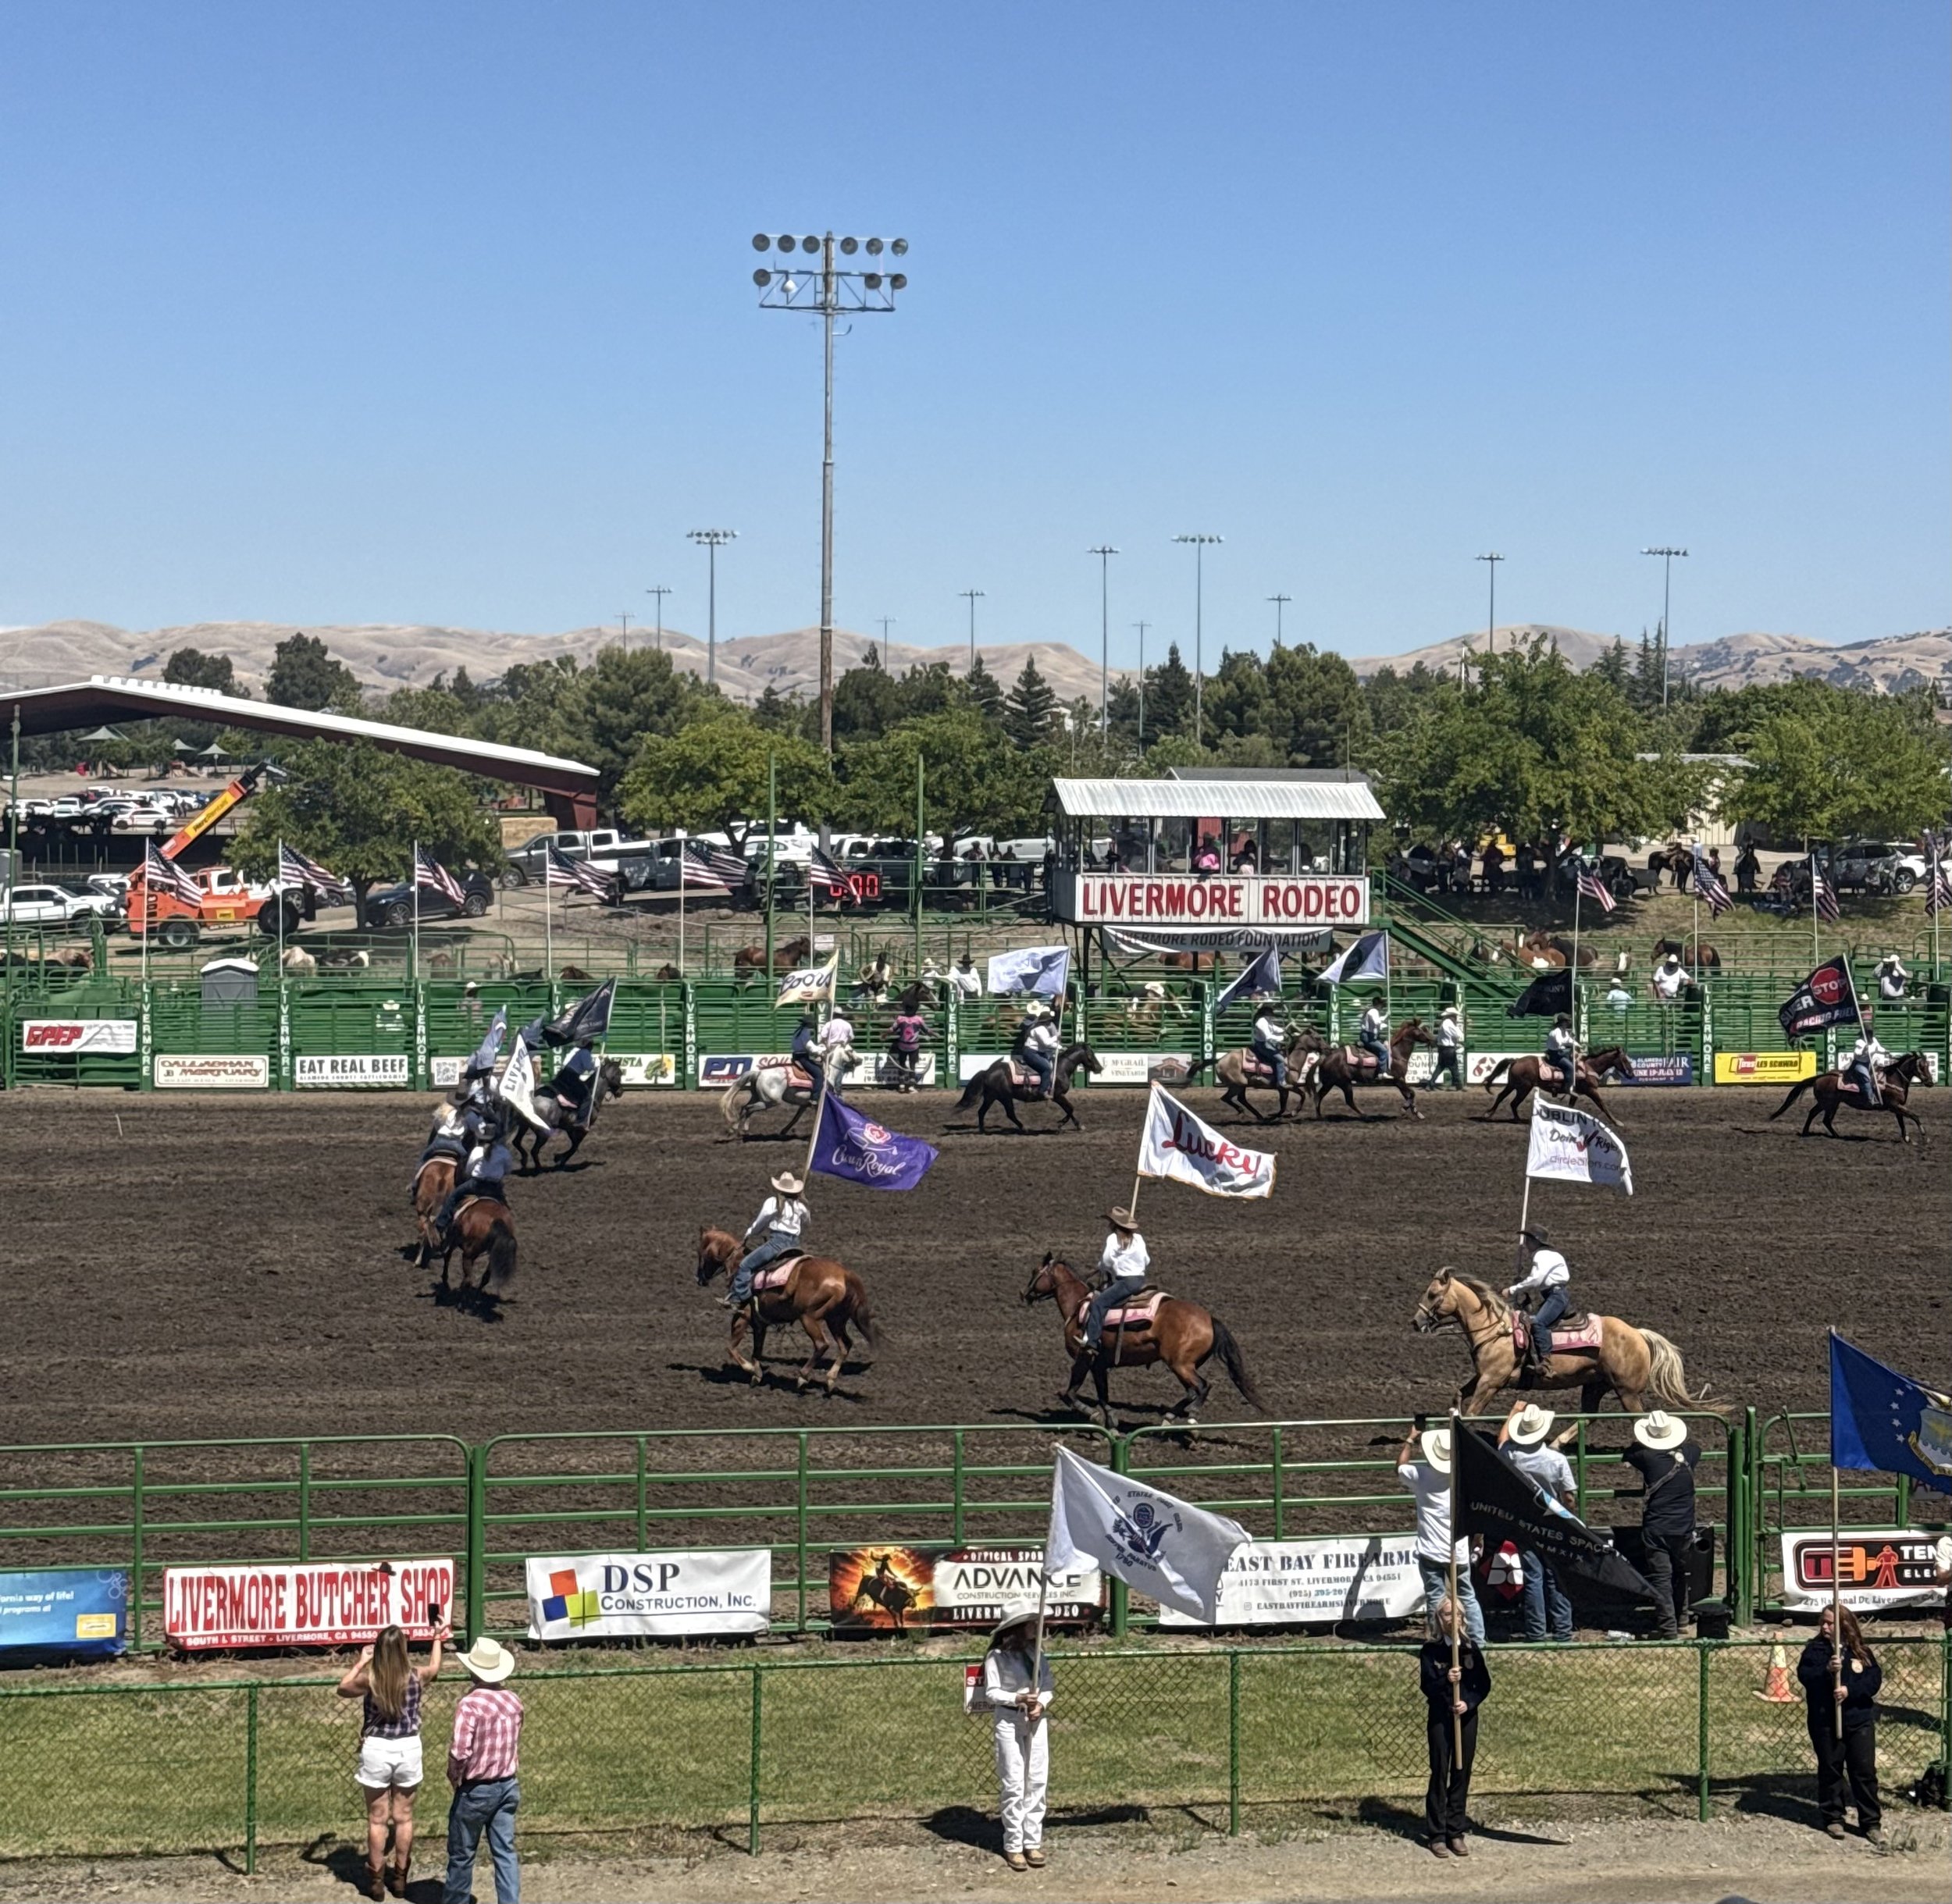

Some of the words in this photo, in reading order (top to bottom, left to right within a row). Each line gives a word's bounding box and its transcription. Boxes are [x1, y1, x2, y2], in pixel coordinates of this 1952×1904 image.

[1083, 882, 1243, 916] LIVERMORE
[1263, 884, 1360, 917] RODEO
[1191, 933, 1234, 946] RODEO
[1812, 974, 1847, 995] STOP
[142, 982, 152, 1077] LIVERMORE
[280, 984, 290, 1077] LIVERMORE
[416, 984, 426, 1075] LIVERMORE
[686, 984, 696, 1075] LIVERMORE
[948, 982, 957, 1073] LIVERMORE
[1704, 984, 1712, 1073] LIVERMORE
[299, 1059, 325, 1074] EAT
[330, 1059, 365, 1074] REAL
[372, 1059, 405, 1073] BEEF
[1162, 1109, 1262, 1180] Lucky
[856, 1151, 907, 1177] Royal
[1470, 1500, 1514, 1521] UNITED
[1518, 1519, 1563, 1541] STATES
[1018, 1550, 1043, 1561] SPON
[1223, 1555, 1273, 1573] EAST
[1281, 1554, 1315, 1572] BAY
[1323, 1549, 1420, 1569] FIREARMS
[601, 1563, 680, 1593] DSP
[1262, 1578, 1288, 1586] FIRST
[0, 1593, 23, 1602] ornia
[25, 1595, 44, 1603] way
[45, 1592, 55, 1601] of
[56, 1590, 75, 1600] life!
[169, 1574, 287, 1633] LIVERMORE
[295, 1571, 391, 1628] BUTCHER
[401, 1568, 451, 1624] SHOP
[600, 1594, 723, 1610] CONSTRUCTION,
[727, 1591, 757, 1607] INC.
[957, 1591, 1021, 1600] CONSTRUCTION
[1023, 1590, 1058, 1599] SERVCES
[1289, 1589, 1312, 1599] (925)
[1821, 1595, 1857, 1606] Naonal
[2, 1606, 41, 1616] programs
[953, 1606, 1002, 1620] LIVERM
[1054, 1604, 1080, 1618] DEO
[187, 1635, 219, 1646] SOUTH
[221, 1635, 228, 1644] L
[230, 1635, 267, 1644] STREET
[334, 1632, 348, 1640] CA
[351, 1630, 379, 1639] 94550
